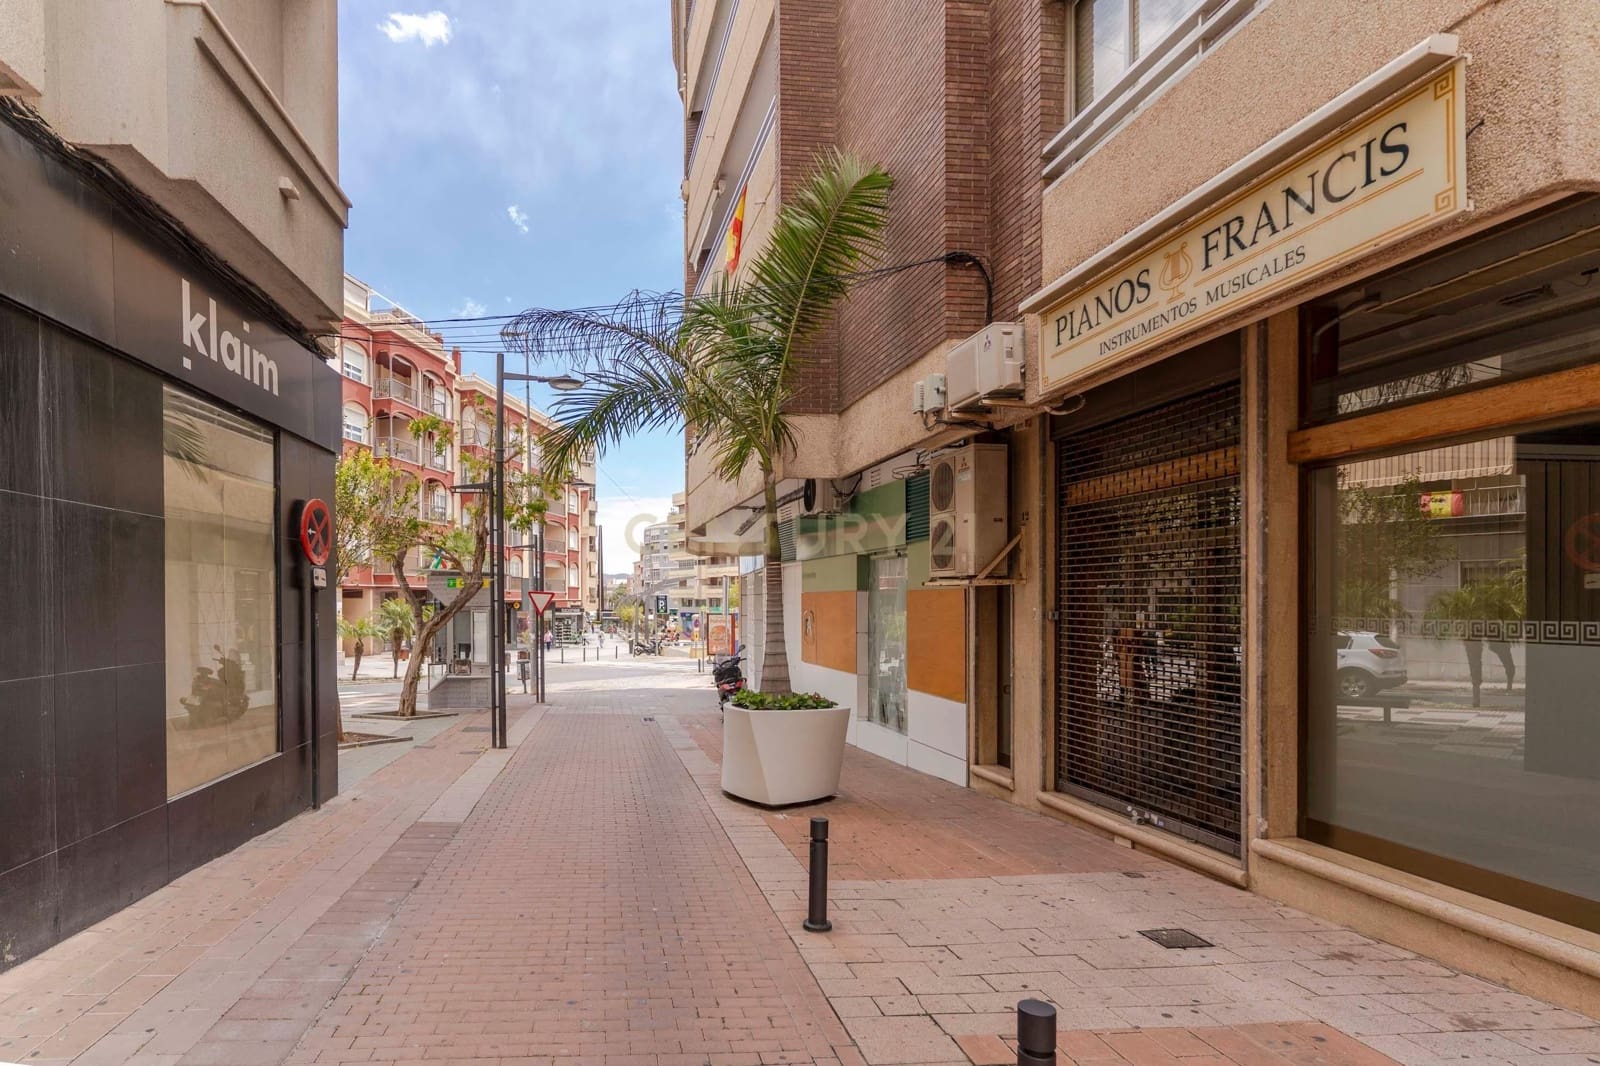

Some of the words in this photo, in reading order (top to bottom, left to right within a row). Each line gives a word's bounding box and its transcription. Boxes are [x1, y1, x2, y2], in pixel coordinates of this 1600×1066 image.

[1055, 268, 1152, 347] PIANOS
[1201, 122, 1410, 271] FRANCIS
[1099, 297, 1198, 355] INSTRUMENTOS
[1205, 245, 1306, 306] MUSICALES
